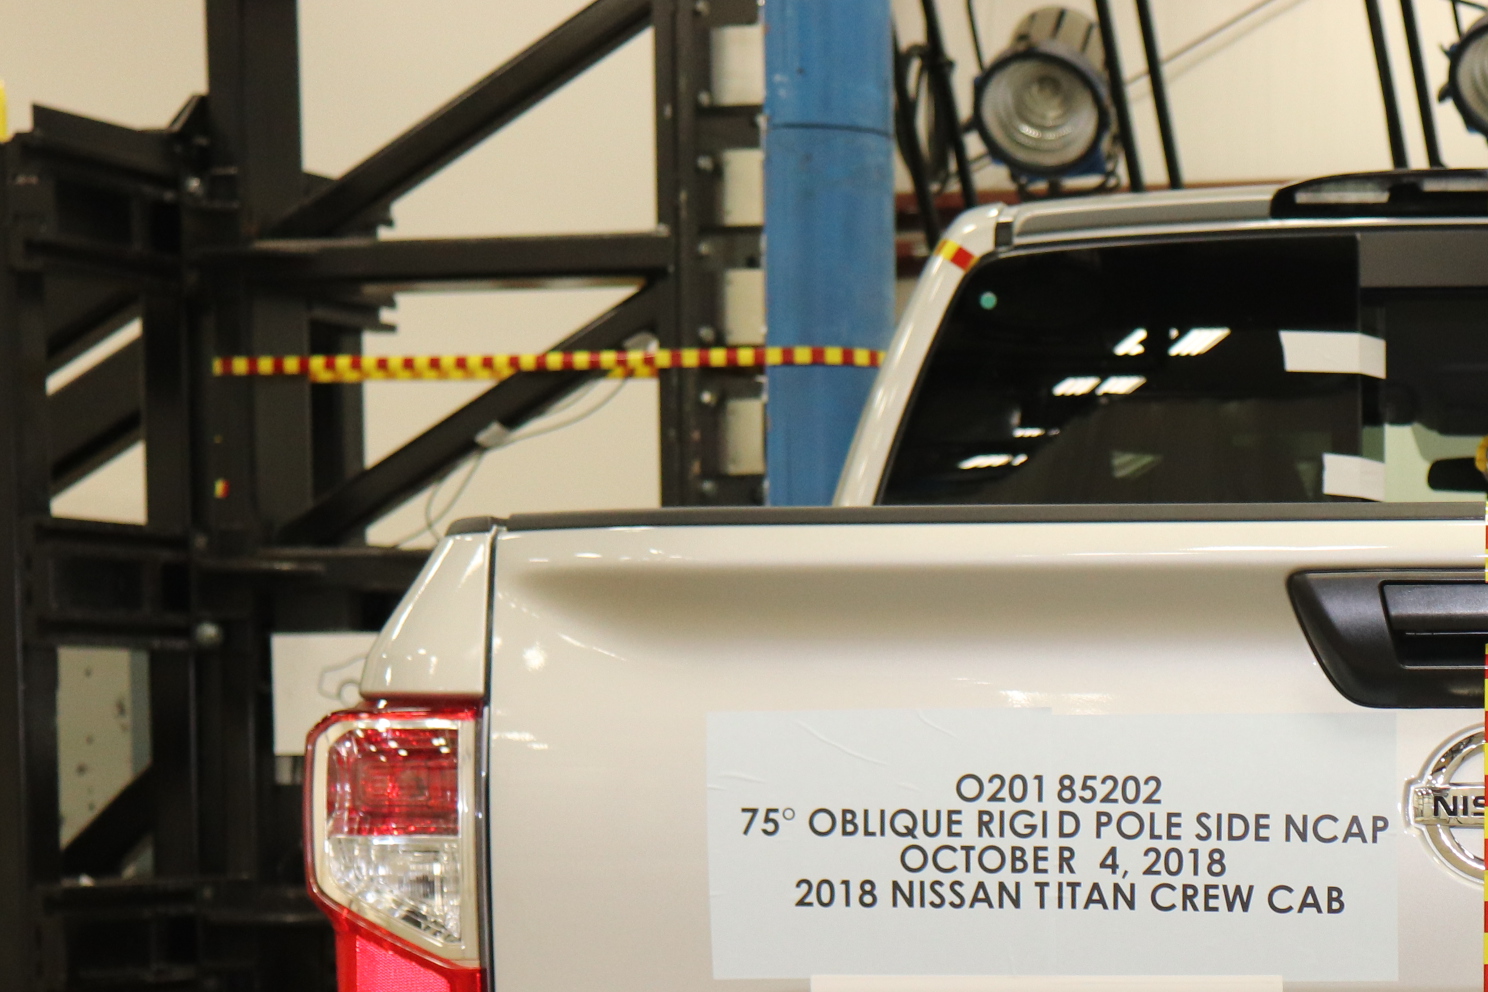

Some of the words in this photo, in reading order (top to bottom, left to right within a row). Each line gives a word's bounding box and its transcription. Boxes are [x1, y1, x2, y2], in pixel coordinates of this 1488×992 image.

[808, 807, 963, 840] OBLIQUE
[977, 809, 1081, 839] RIGID
[1095, 810, 1182, 841] POLE
[1194, 811, 1271, 842] SIDE
[1284, 813, 1389, 844] NCAP
[899, 844, 1076, 875] OCTOBER
[1099, 846, 1129, 880] 4,
[1142, 846, 1227, 878] 2018
[794, 878, 878, 909] 2018
[891, 879, 1021, 910] NISSAN
[1034, 881, 1136, 911] TITAN
[1150, 882, 1255, 913] CREW
[1267, 884, 1345, 915] CAB
